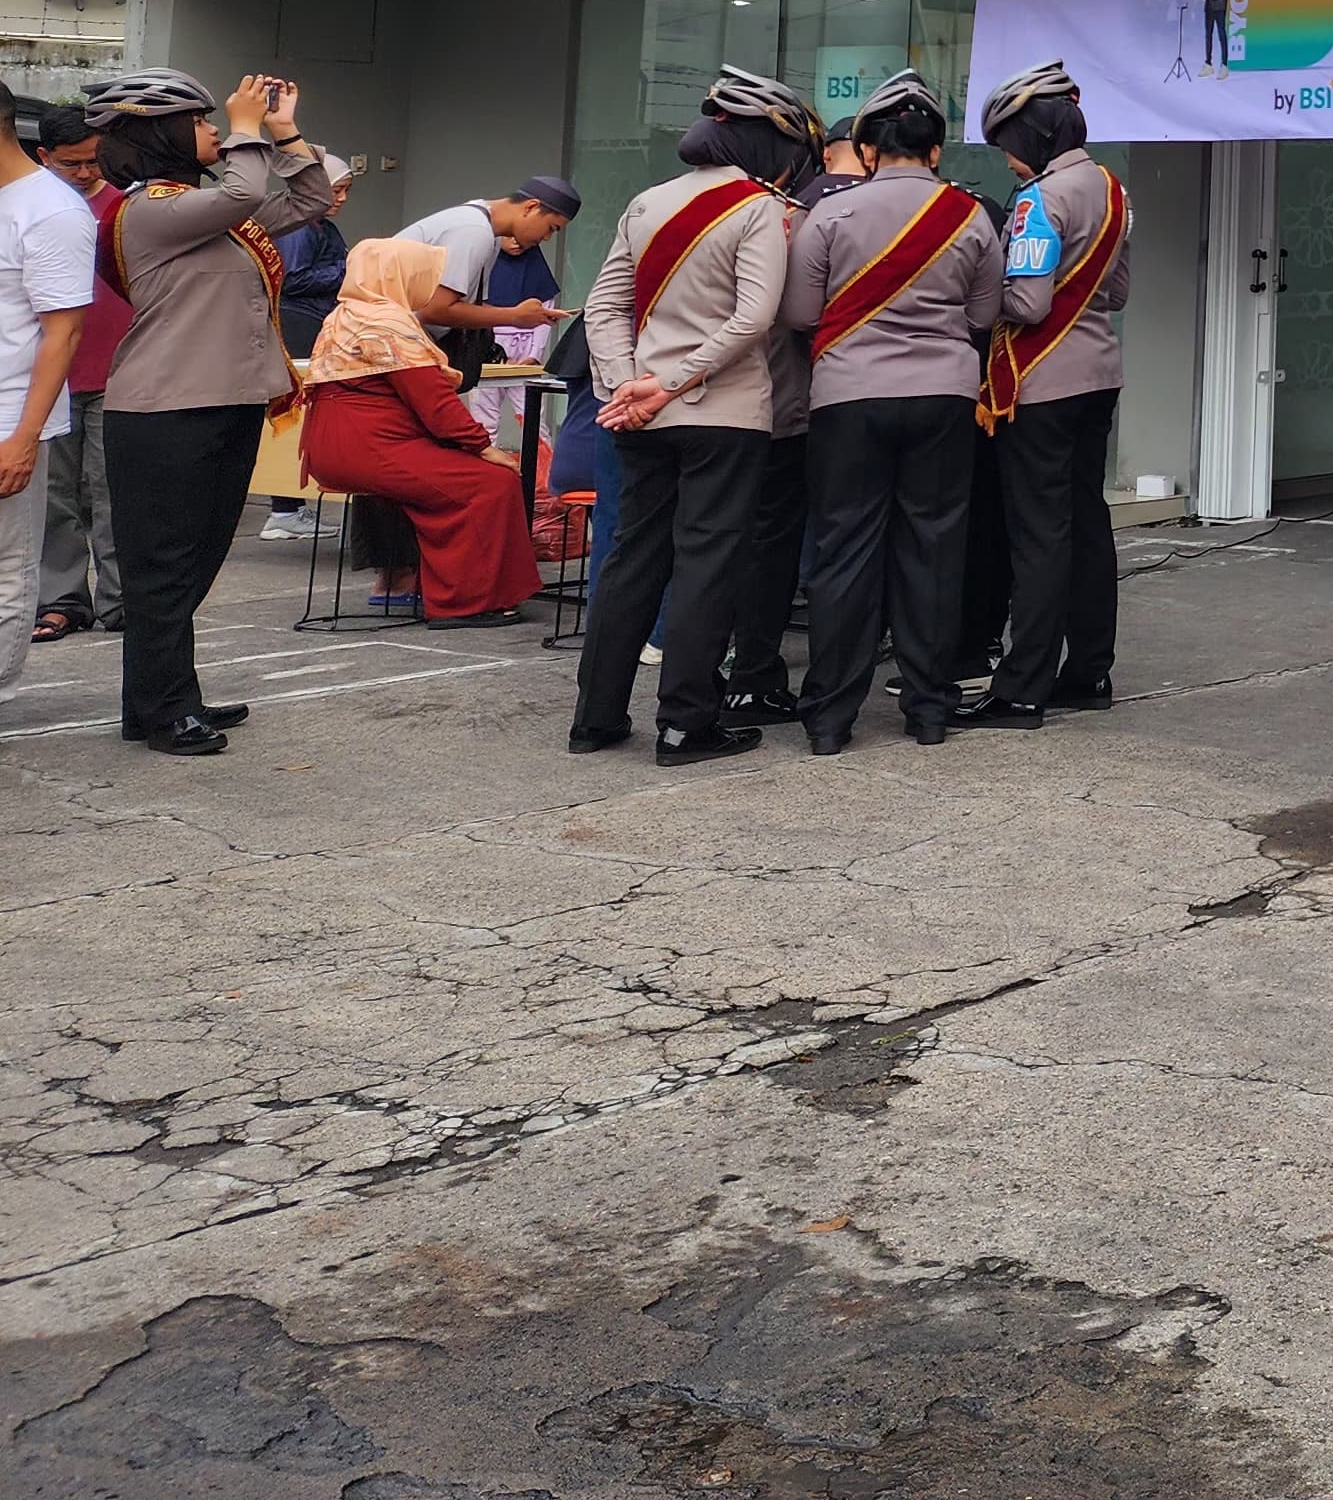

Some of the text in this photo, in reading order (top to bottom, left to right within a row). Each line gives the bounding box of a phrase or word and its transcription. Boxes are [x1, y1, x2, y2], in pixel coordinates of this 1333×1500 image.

[827, 77, 858, 98] BSI
[1274, 87, 1332, 115] by BSI
[240, 218, 283, 276] POLRESTA
